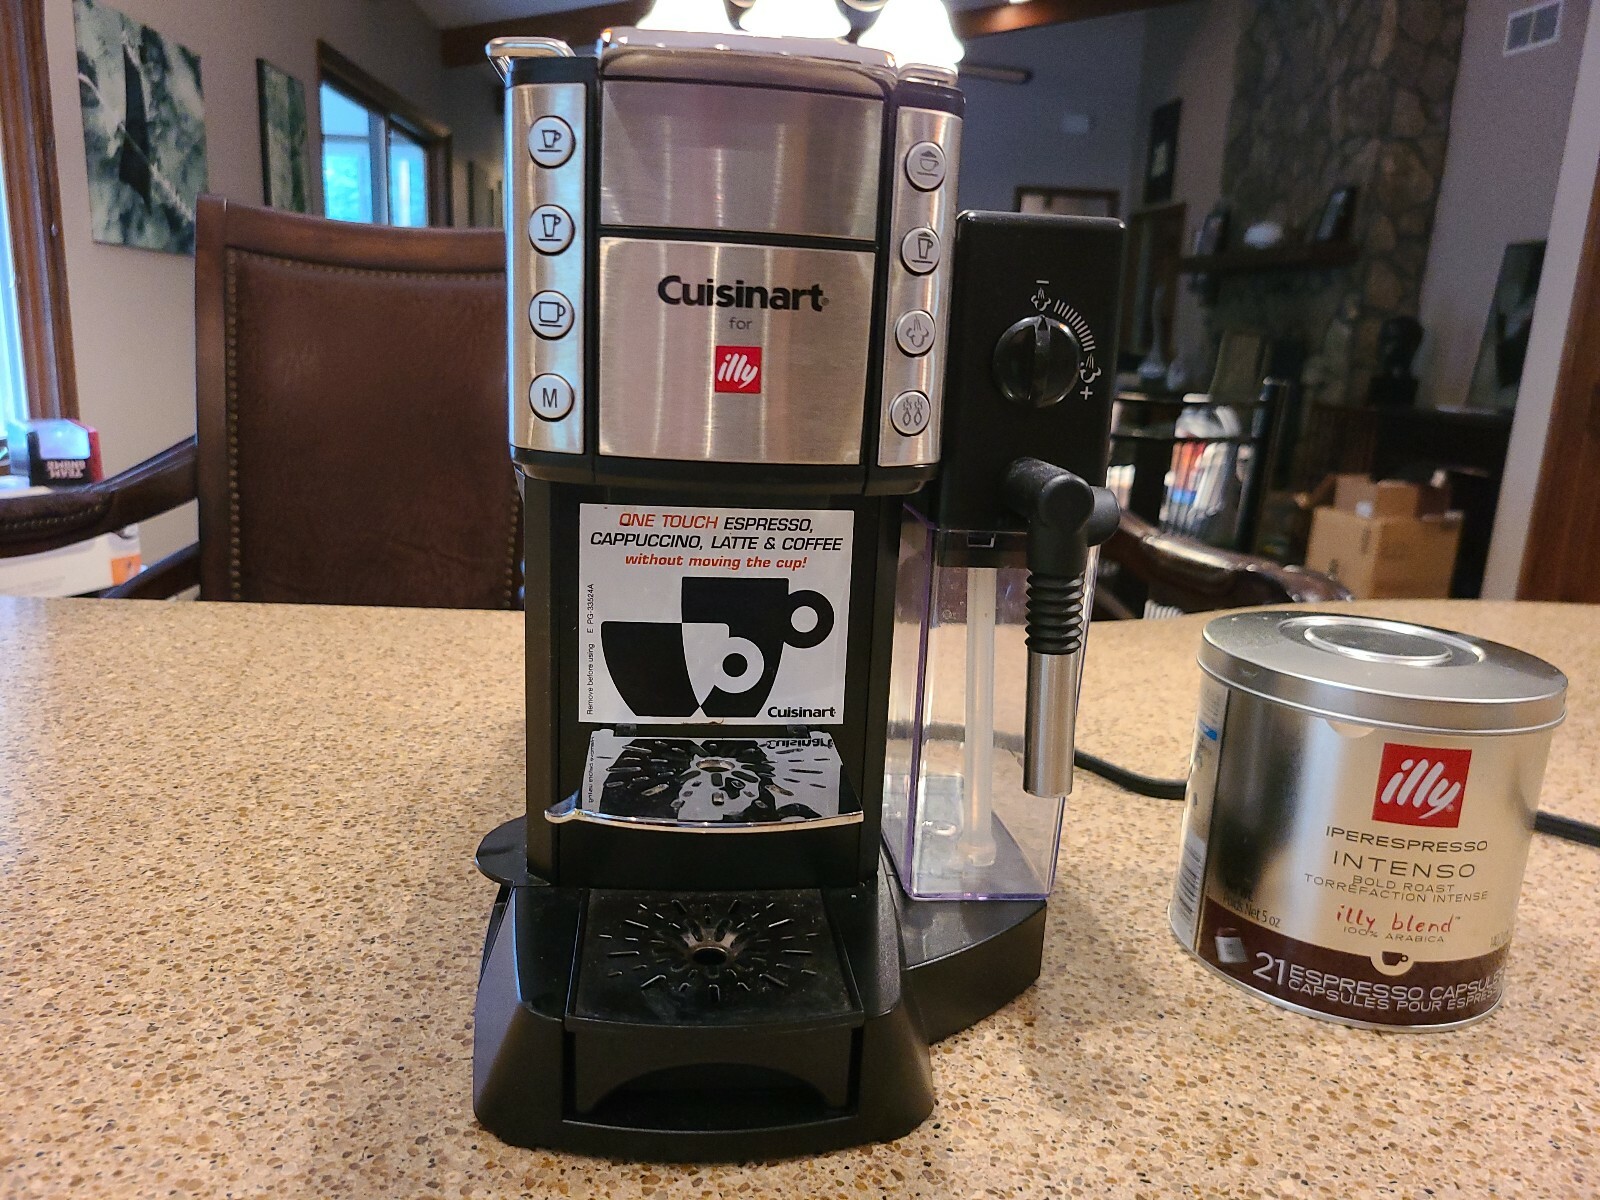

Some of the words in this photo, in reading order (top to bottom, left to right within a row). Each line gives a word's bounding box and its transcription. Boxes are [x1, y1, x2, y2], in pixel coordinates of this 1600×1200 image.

[658, 275, 824, 312] Cuisinart
[728, 317, 753, 330] for
[717, 353, 759, 389] illy
[542, 387, 558, 409] M
[619, 513, 656, 528] ONE
[662, 514, 719, 530] TOUCH
[723, 517, 814, 533] ESPRESSO,
[590, 532, 704, 551] CAPPUCCINO,
[711, 536, 759, 550] LATTE
[764, 537, 776, 550] &
[782, 537, 844, 551] COFFEE
[625, 554, 683, 566] without
[688, 555, 741, 570] moving
[746, 557, 771, 568] the
[776, 557, 808, 571] cup!
[586, 643, 595, 662] using
[586, 663, 594, 686] before
[586, 687, 594, 715] Remove
[767, 706, 836, 718] Cuisinart
[1381, 759, 1461, 819] illy
[1325, 825, 1488, 853] IPERESPRESSO
[1333, 850, 1476, 879] INTENSO
[1353, 874, 1396, 889] BOLD
[1403, 882, 1455, 893] ROAST
[1432, 890, 1489, 903] INTENSE
[1261, 910, 1268, 923] 5
[1269, 916, 1281, 928] oz
[1336, 904, 1376, 932] illy
[1391, 912, 1455, 933] blend
[1343, 926, 1378, 938] 100%
[1385, 933, 1444, 943] ARABICA
[1252, 951, 1286, 986] 21
[1290, 963, 1424, 1001] ESPRESSO
[1430, 970, 1501, 1001] CAPSULE
[1288, 979, 1391, 1010] CAPSULES
[1396, 1000, 1441, 1012] POUR
